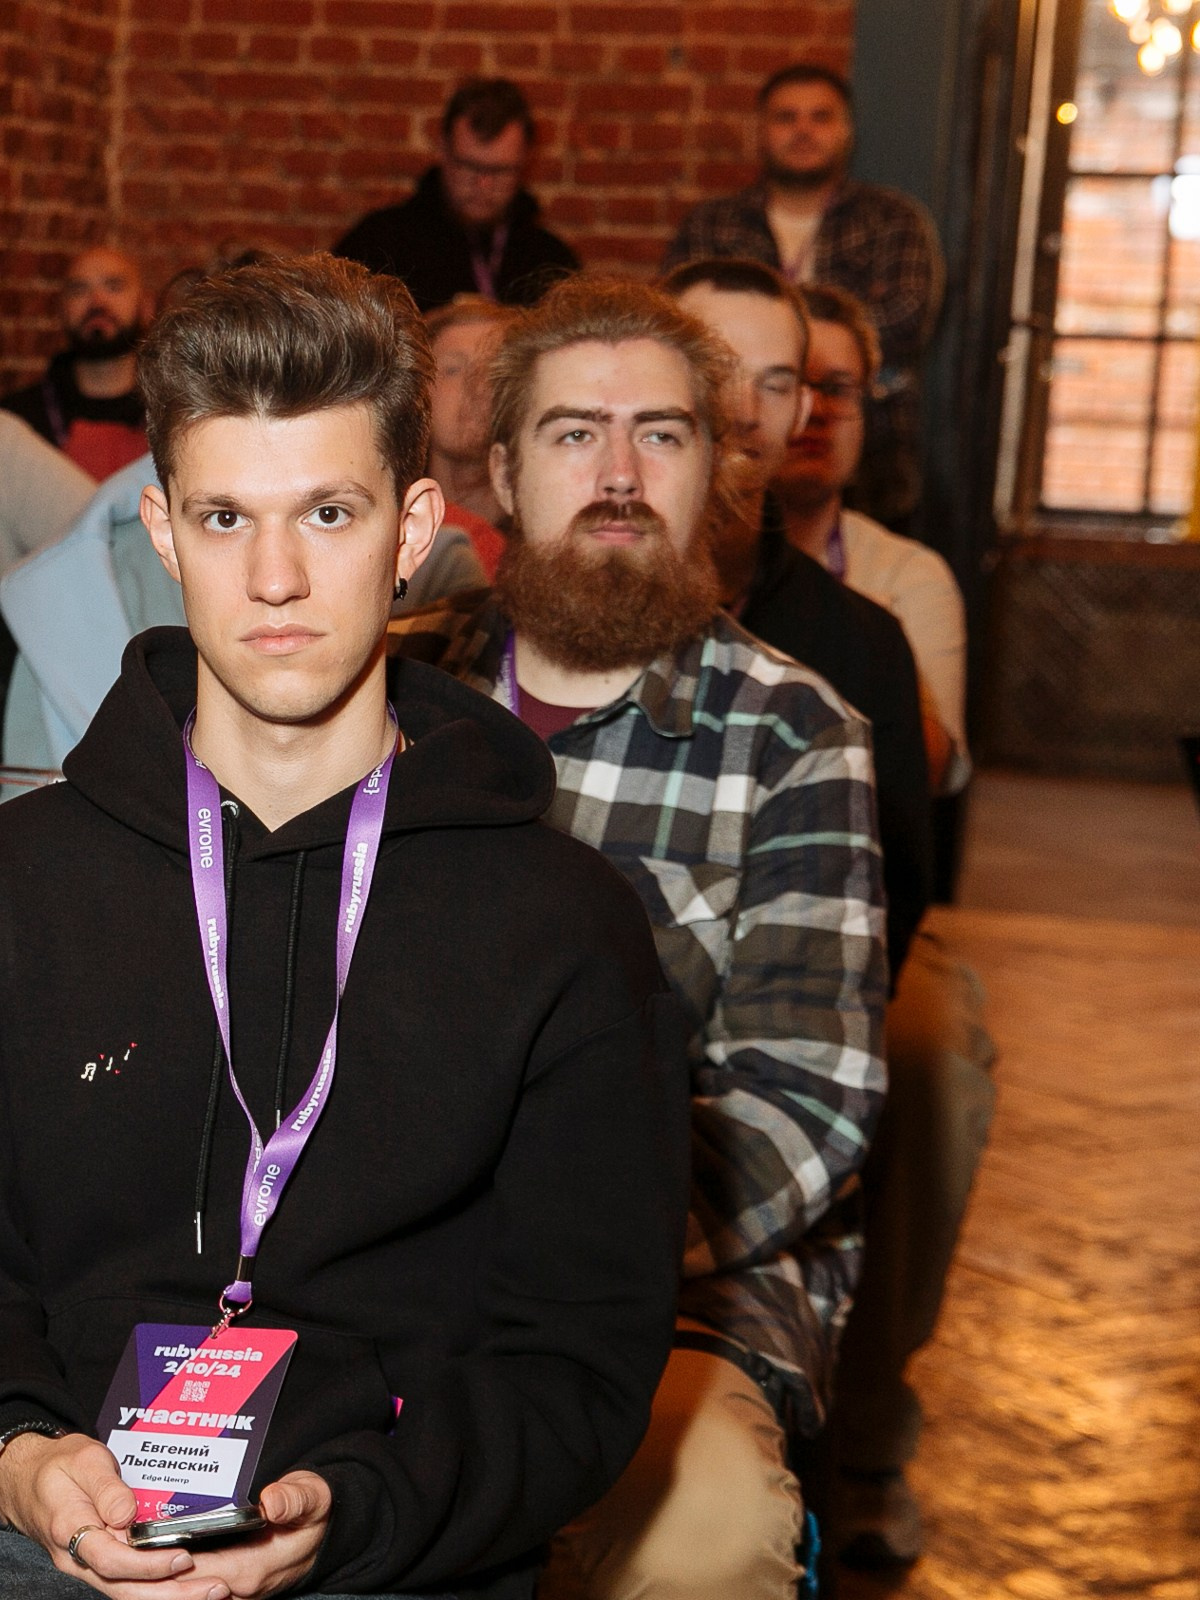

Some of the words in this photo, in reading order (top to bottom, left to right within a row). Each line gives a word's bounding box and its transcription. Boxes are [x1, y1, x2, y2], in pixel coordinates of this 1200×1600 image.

[345, 841, 369, 933] rubyrussia
[197, 808, 213, 869] evrone
[207, 918, 225, 1010] rubyrussia
[254, 1163, 281, 1227] evrone
[291, 1049, 332, 1131] rubyrussia
[153, 1344, 263, 1362] rubyrussia
[163, 1360, 242, 1378] 2/10/24
[118, 1407, 255, 1431] участник
[140, 1440, 210, 1457] Евгений
[121, 1454, 220, 1473] Лысанский
[141, 1474, 162, 1482] Edge
[163, 1474, 189, 1484] Центр
